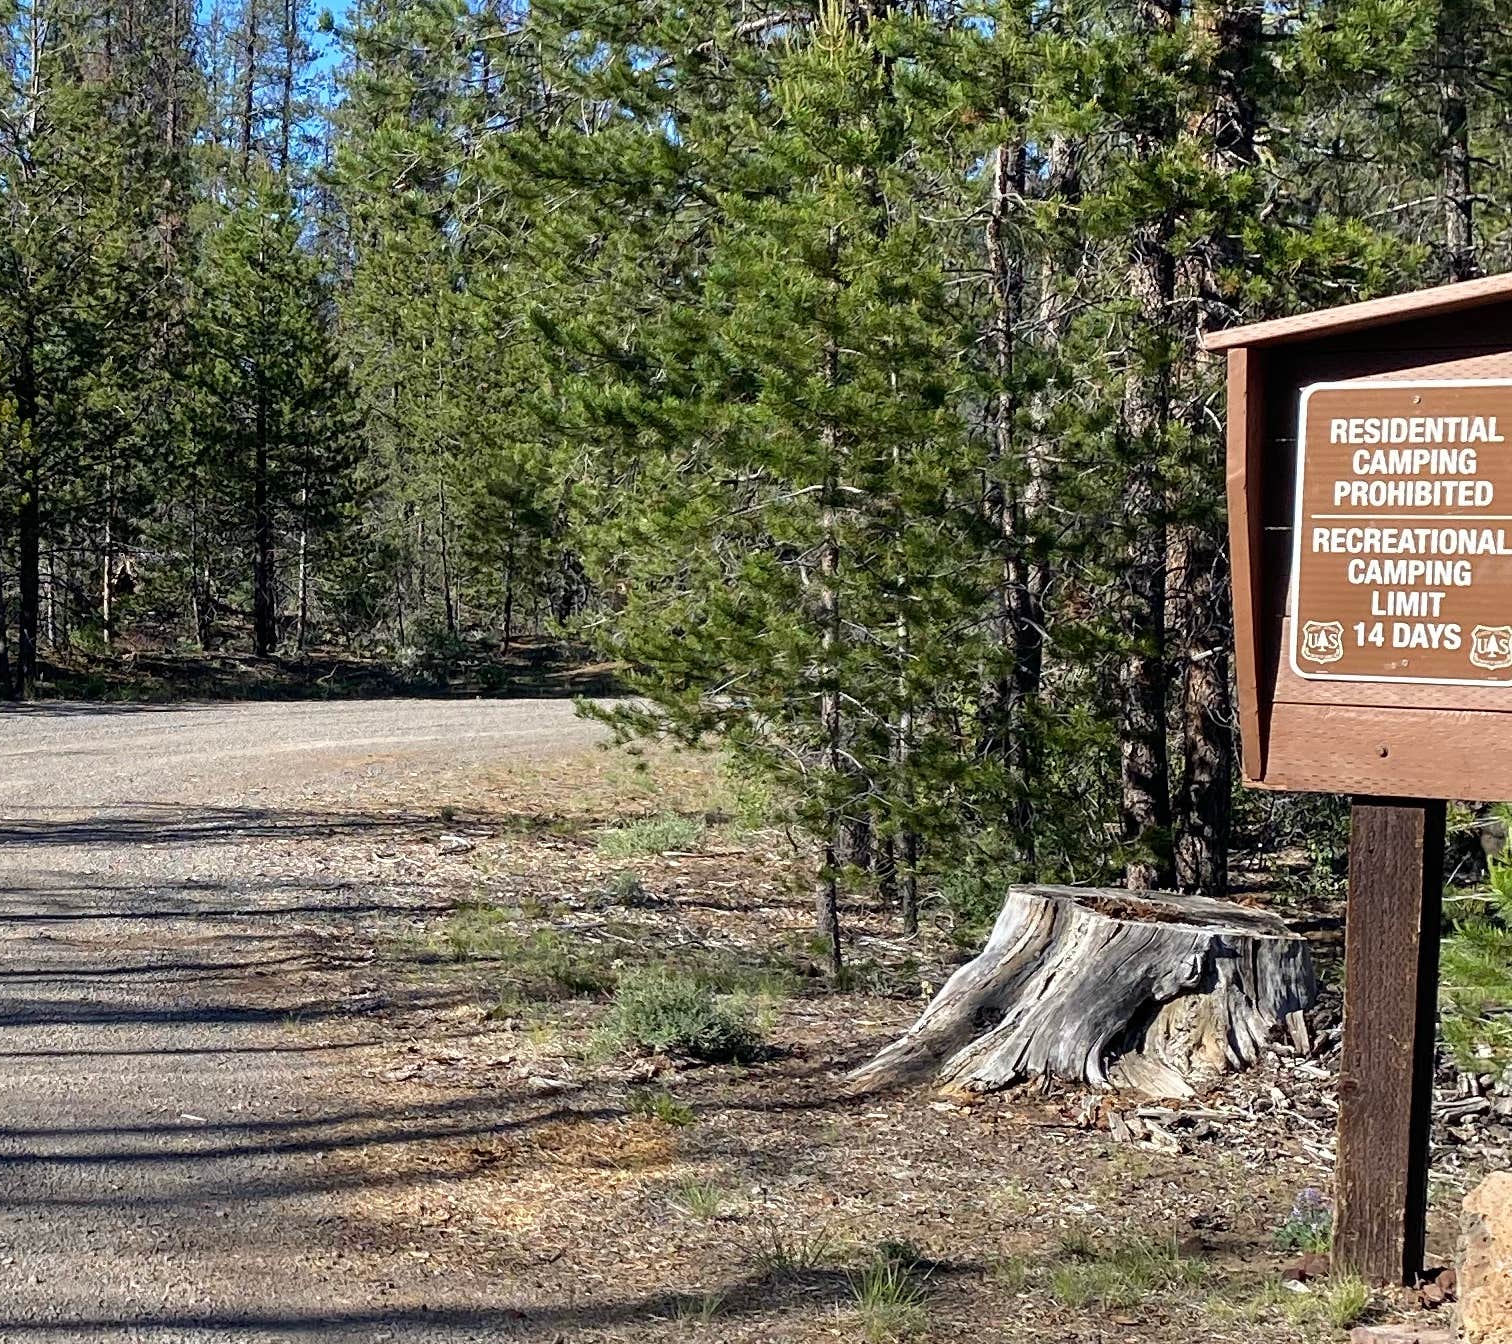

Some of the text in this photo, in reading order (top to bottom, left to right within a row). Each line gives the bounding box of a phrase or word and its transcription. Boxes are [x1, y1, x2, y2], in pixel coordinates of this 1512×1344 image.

[1330, 416, 1505, 444] RESIDENTIAL
[1352, 448, 1477, 475] CAMPING
[1334, 480, 1494, 506] PROHIBITED
[1312, 527, 1512, 555] RECREATIONAL
[1348, 559, 1472, 586] CAMPING
[1371, 590, 1446, 617] LIMIT
[1353, 621, 1462, 650] 14 DAYS
